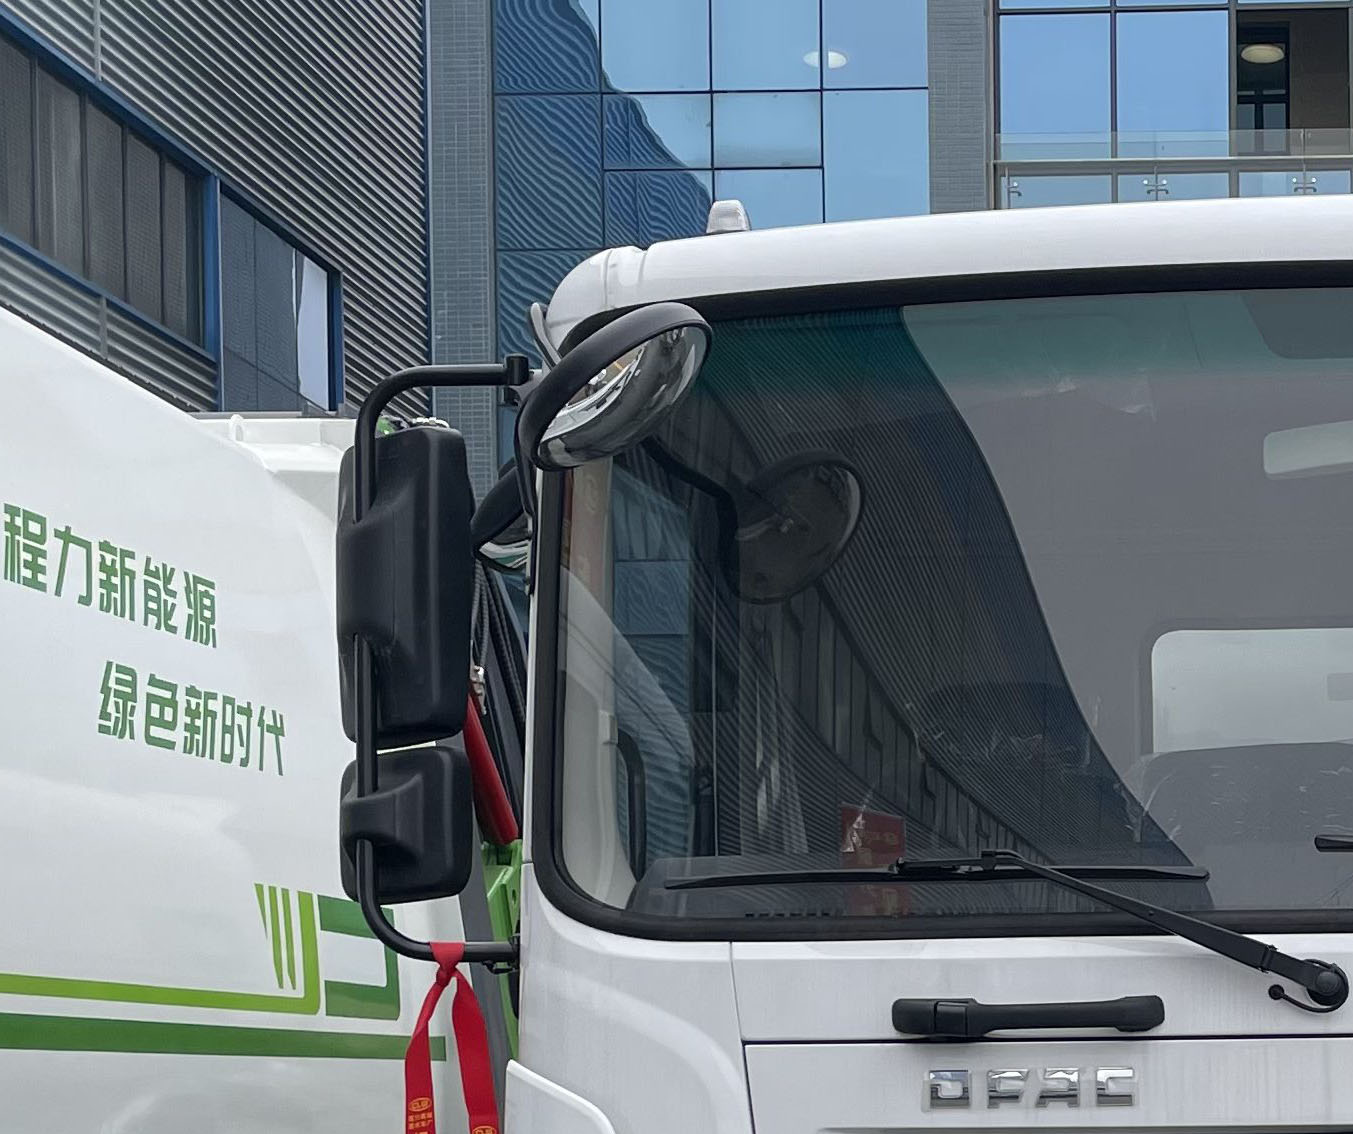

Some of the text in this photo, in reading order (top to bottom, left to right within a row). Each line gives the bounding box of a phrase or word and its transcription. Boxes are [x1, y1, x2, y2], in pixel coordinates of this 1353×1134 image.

[4, 502, 217, 648] 程力新能源
[97, 660, 285, 776] 绿色新时代
[928, 1067, 1134, 1110] DFAC
